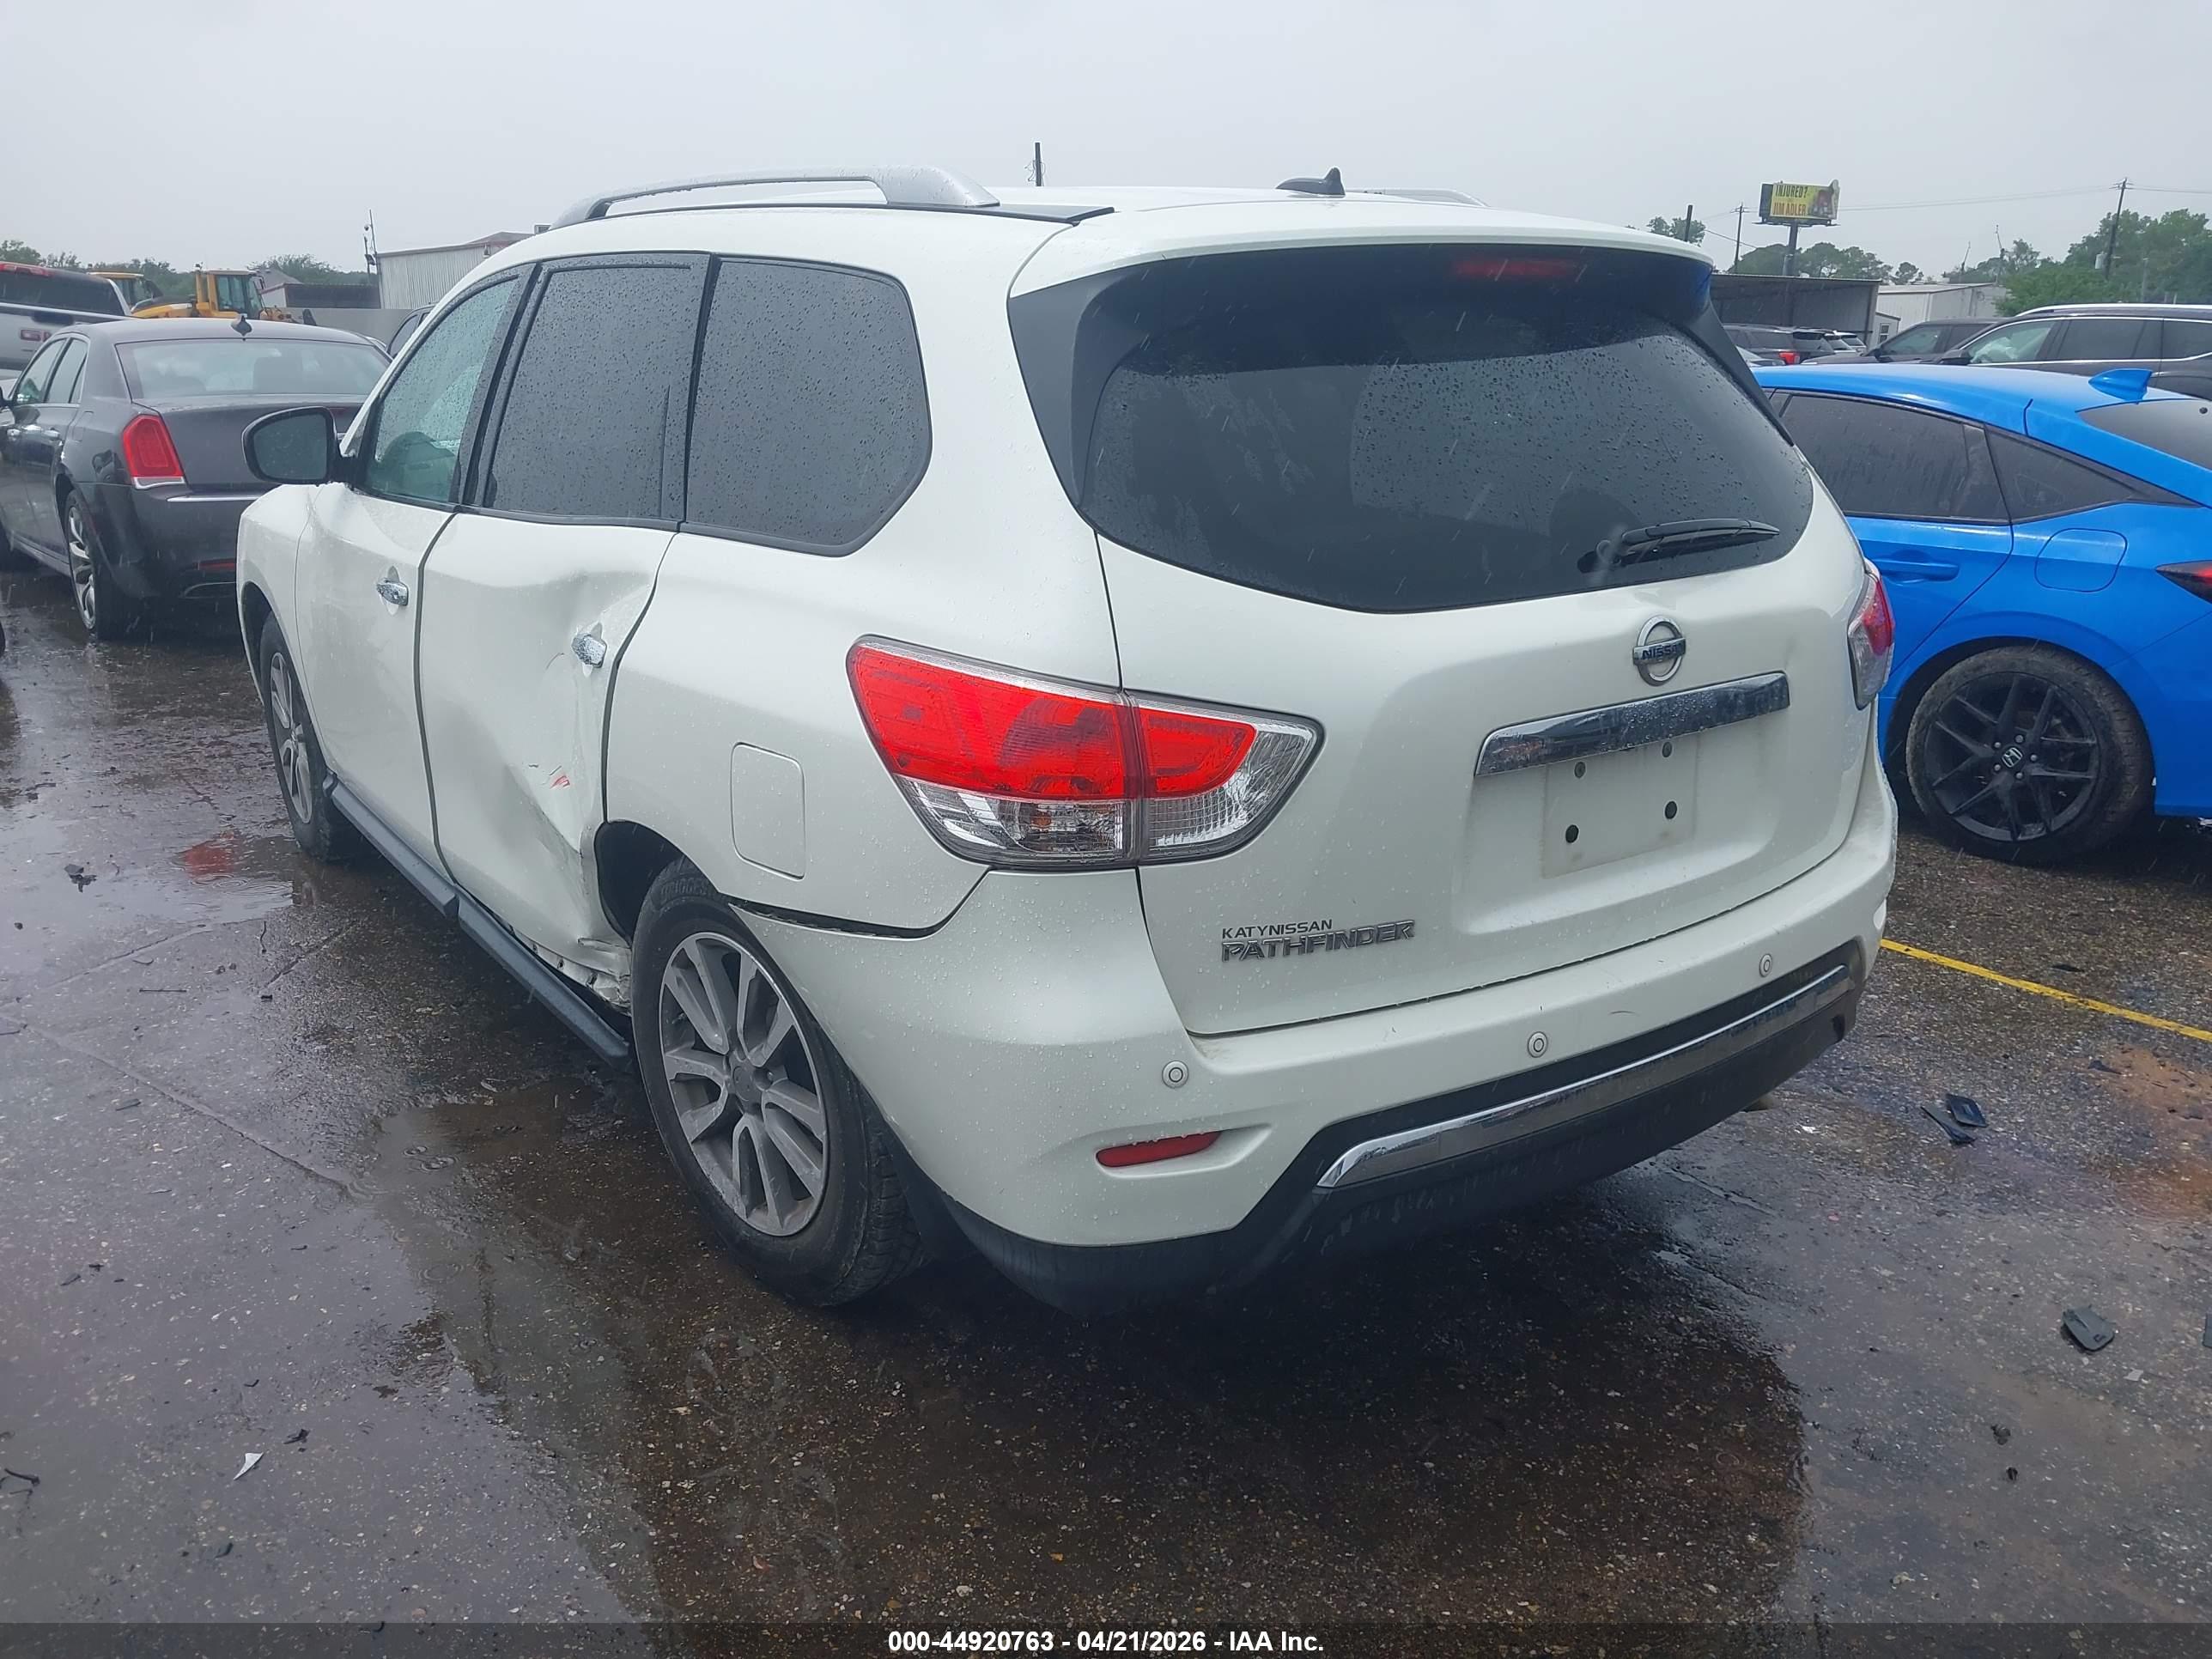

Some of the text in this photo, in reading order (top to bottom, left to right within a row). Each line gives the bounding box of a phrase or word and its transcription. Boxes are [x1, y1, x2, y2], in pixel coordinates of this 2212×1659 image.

[1775, 185, 1808, 198] INJURED?
[1773, 202, 1807, 216] JIM ADLER
[1221, 920, 1415, 962] PATHFINDER
